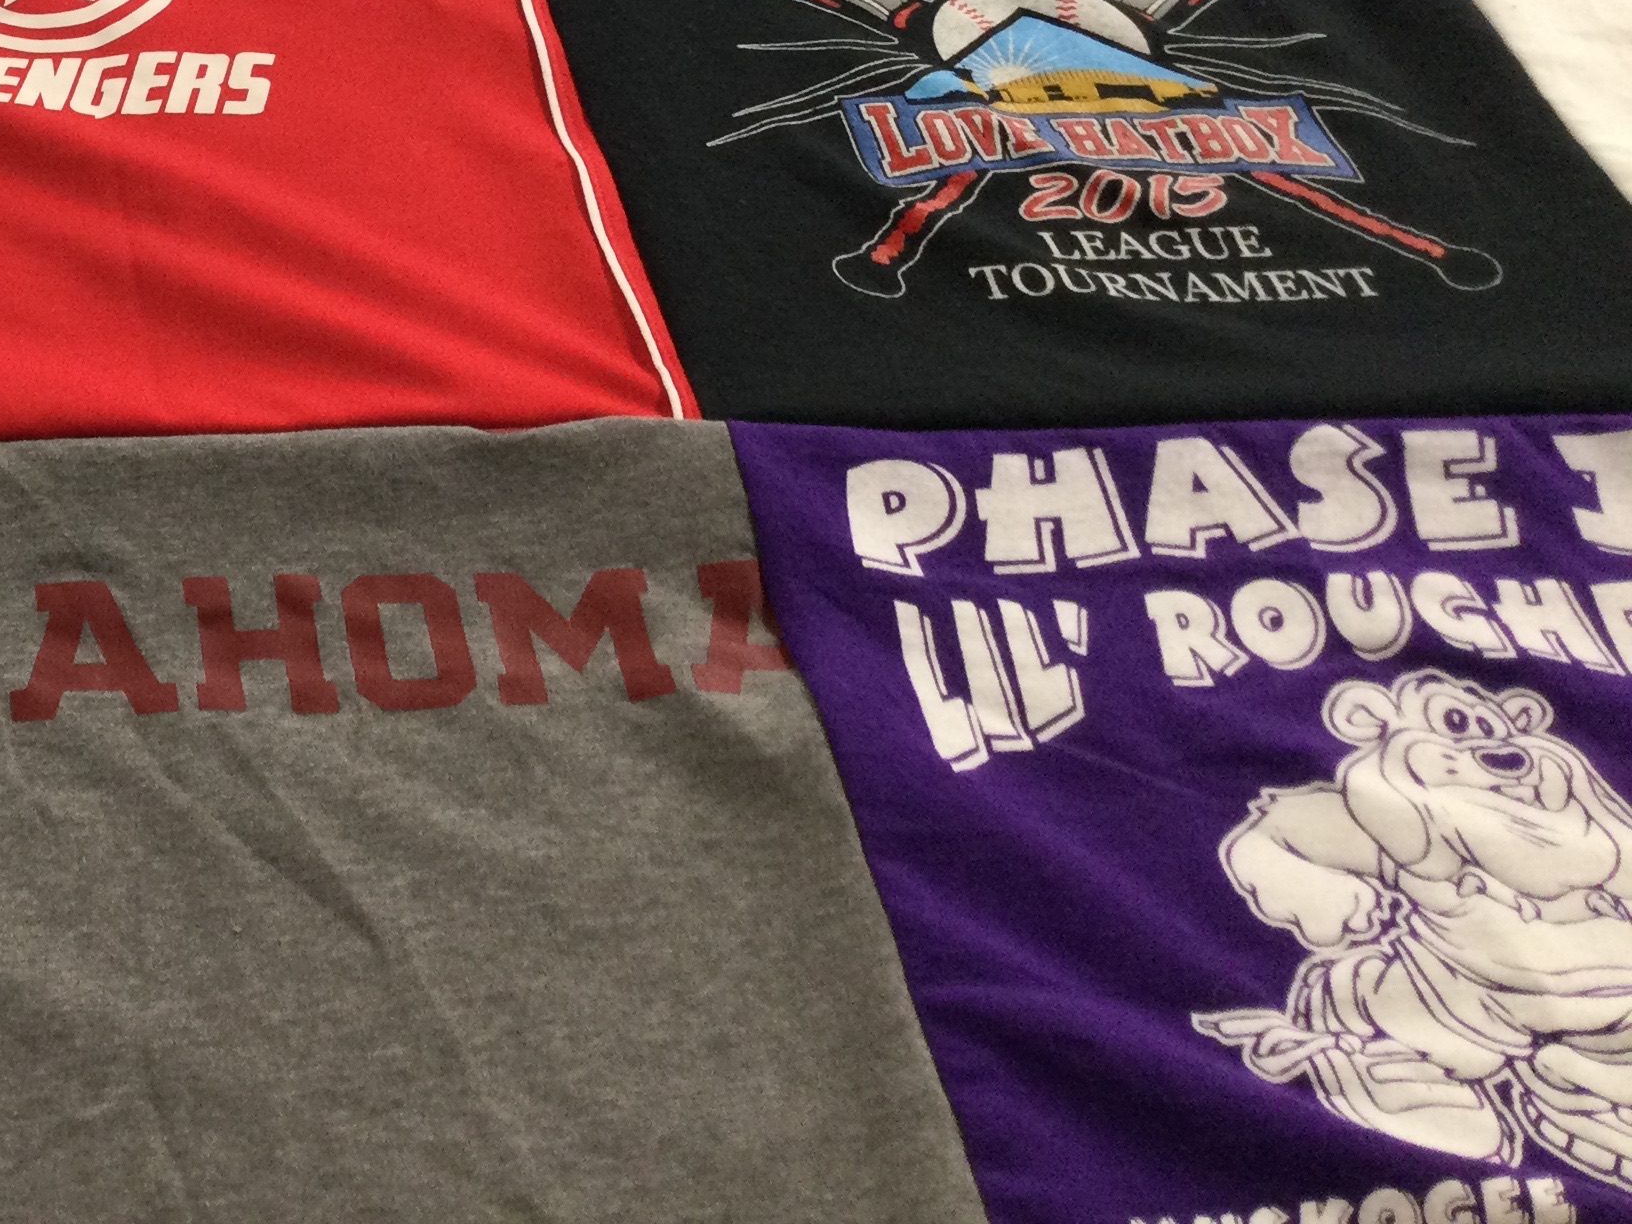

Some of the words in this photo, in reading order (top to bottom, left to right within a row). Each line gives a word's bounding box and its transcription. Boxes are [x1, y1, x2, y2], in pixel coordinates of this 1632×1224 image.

[859, 101, 1056, 176] LOVE
[1051, 104, 1335, 168] HATBOX
[1019, 170, 1228, 223] 2015
[1037, 225, 1273, 261] LEAGUE
[969, 261, 1379, 304] TOURNAMENT
[845, 423, 1520, 576] PHASE
